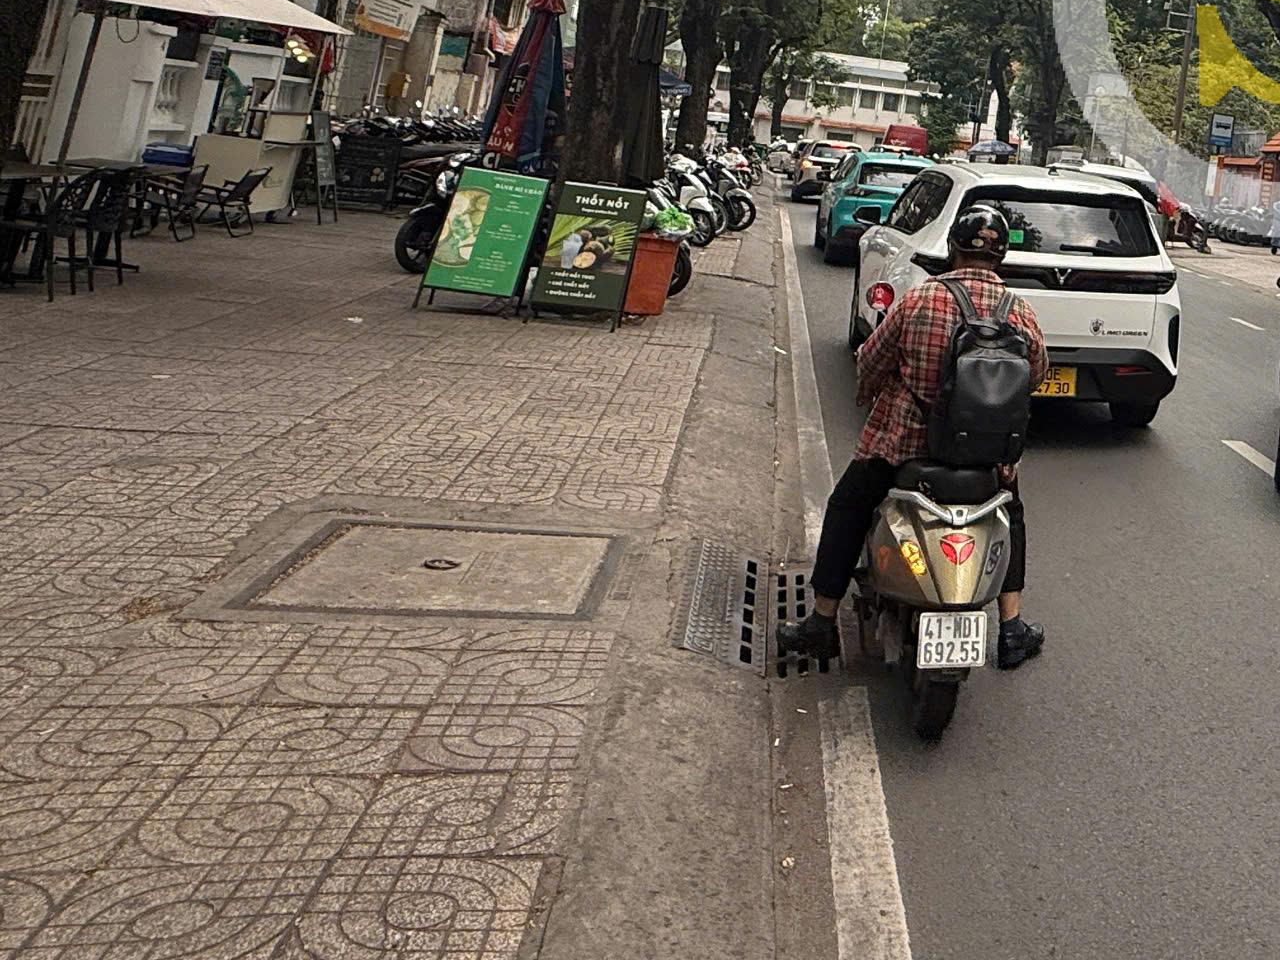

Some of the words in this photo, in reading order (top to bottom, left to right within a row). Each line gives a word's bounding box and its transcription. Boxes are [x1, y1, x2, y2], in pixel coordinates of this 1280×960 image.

[575, 193, 605, 207] THỐT
[606, 196, 630, 210] NỐT
[1046, 368, 1061, 381] 0E
[1036, 382, 1070, 395] 7.30
[923, 641, 980, 664] 692.55
